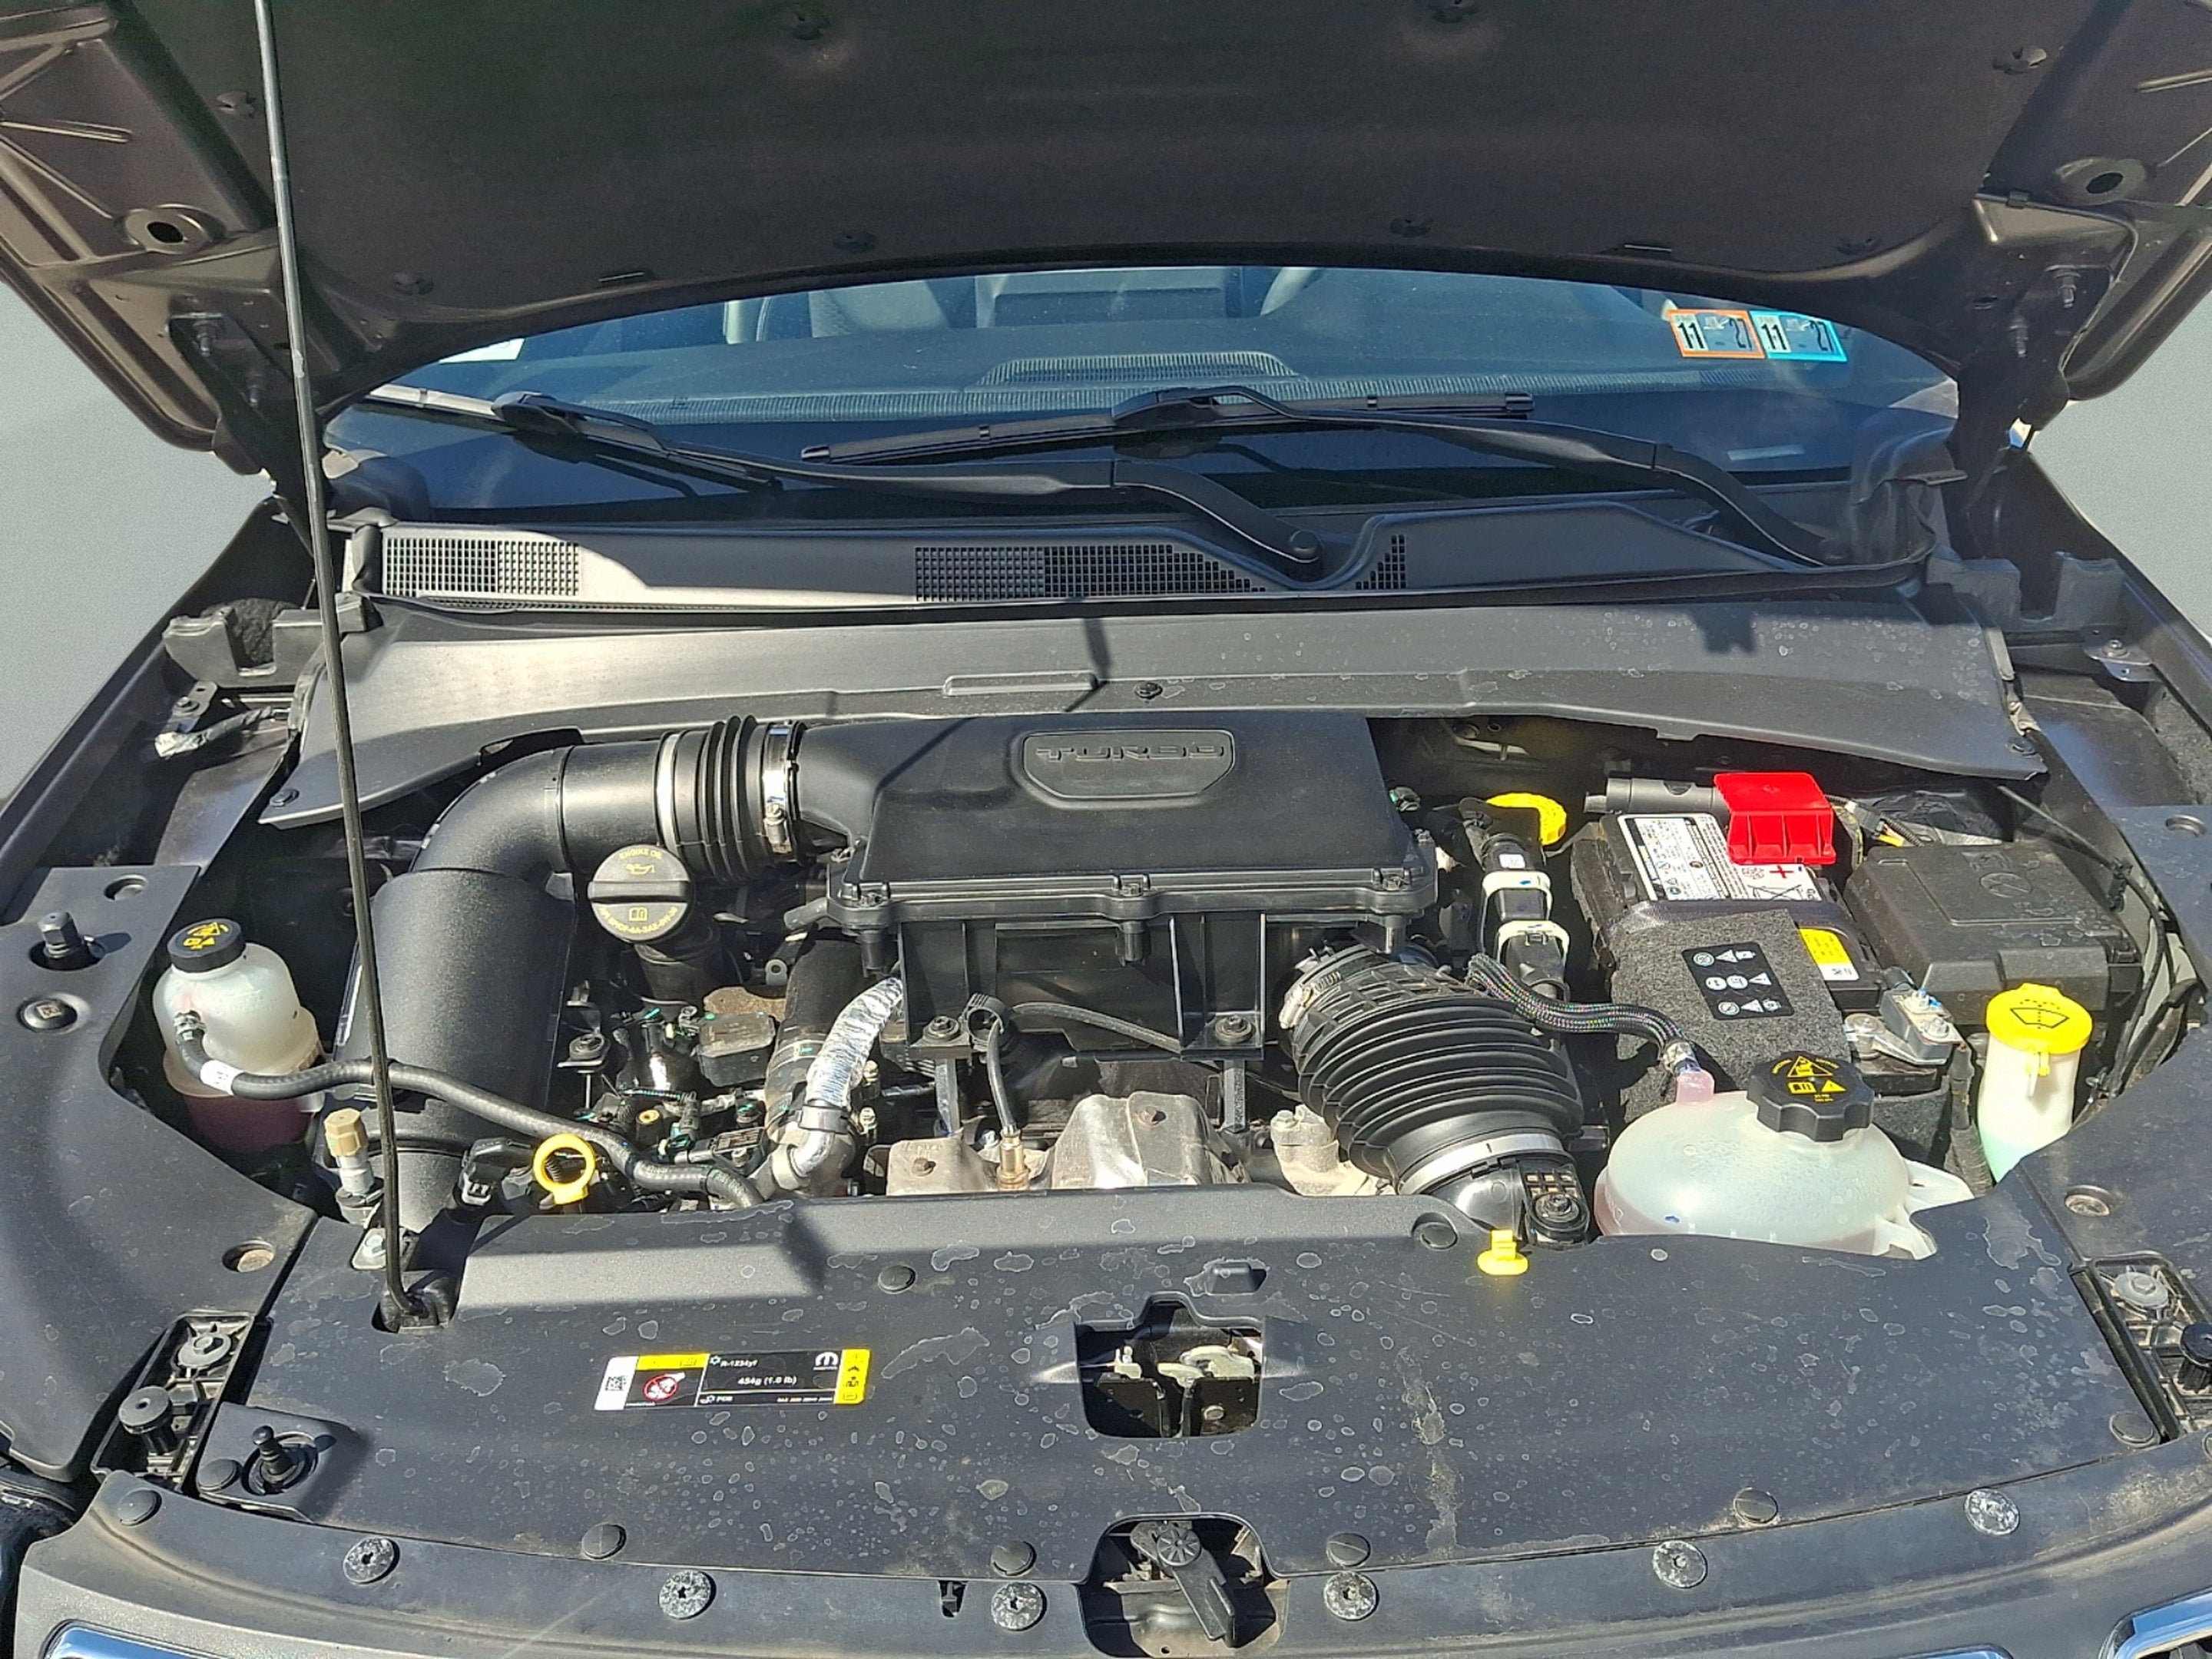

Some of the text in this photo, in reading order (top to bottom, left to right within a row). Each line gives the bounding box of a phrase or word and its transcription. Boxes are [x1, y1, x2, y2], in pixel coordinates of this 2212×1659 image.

[1677, 322, 1704, 349] 11
[1761, 323, 1786, 349] 11
[1036, 745, 1225, 762] TURBO
[619, 847, 663, 859] ENGINE OIL
[720, 1359, 759, 1368] R-1234yf
